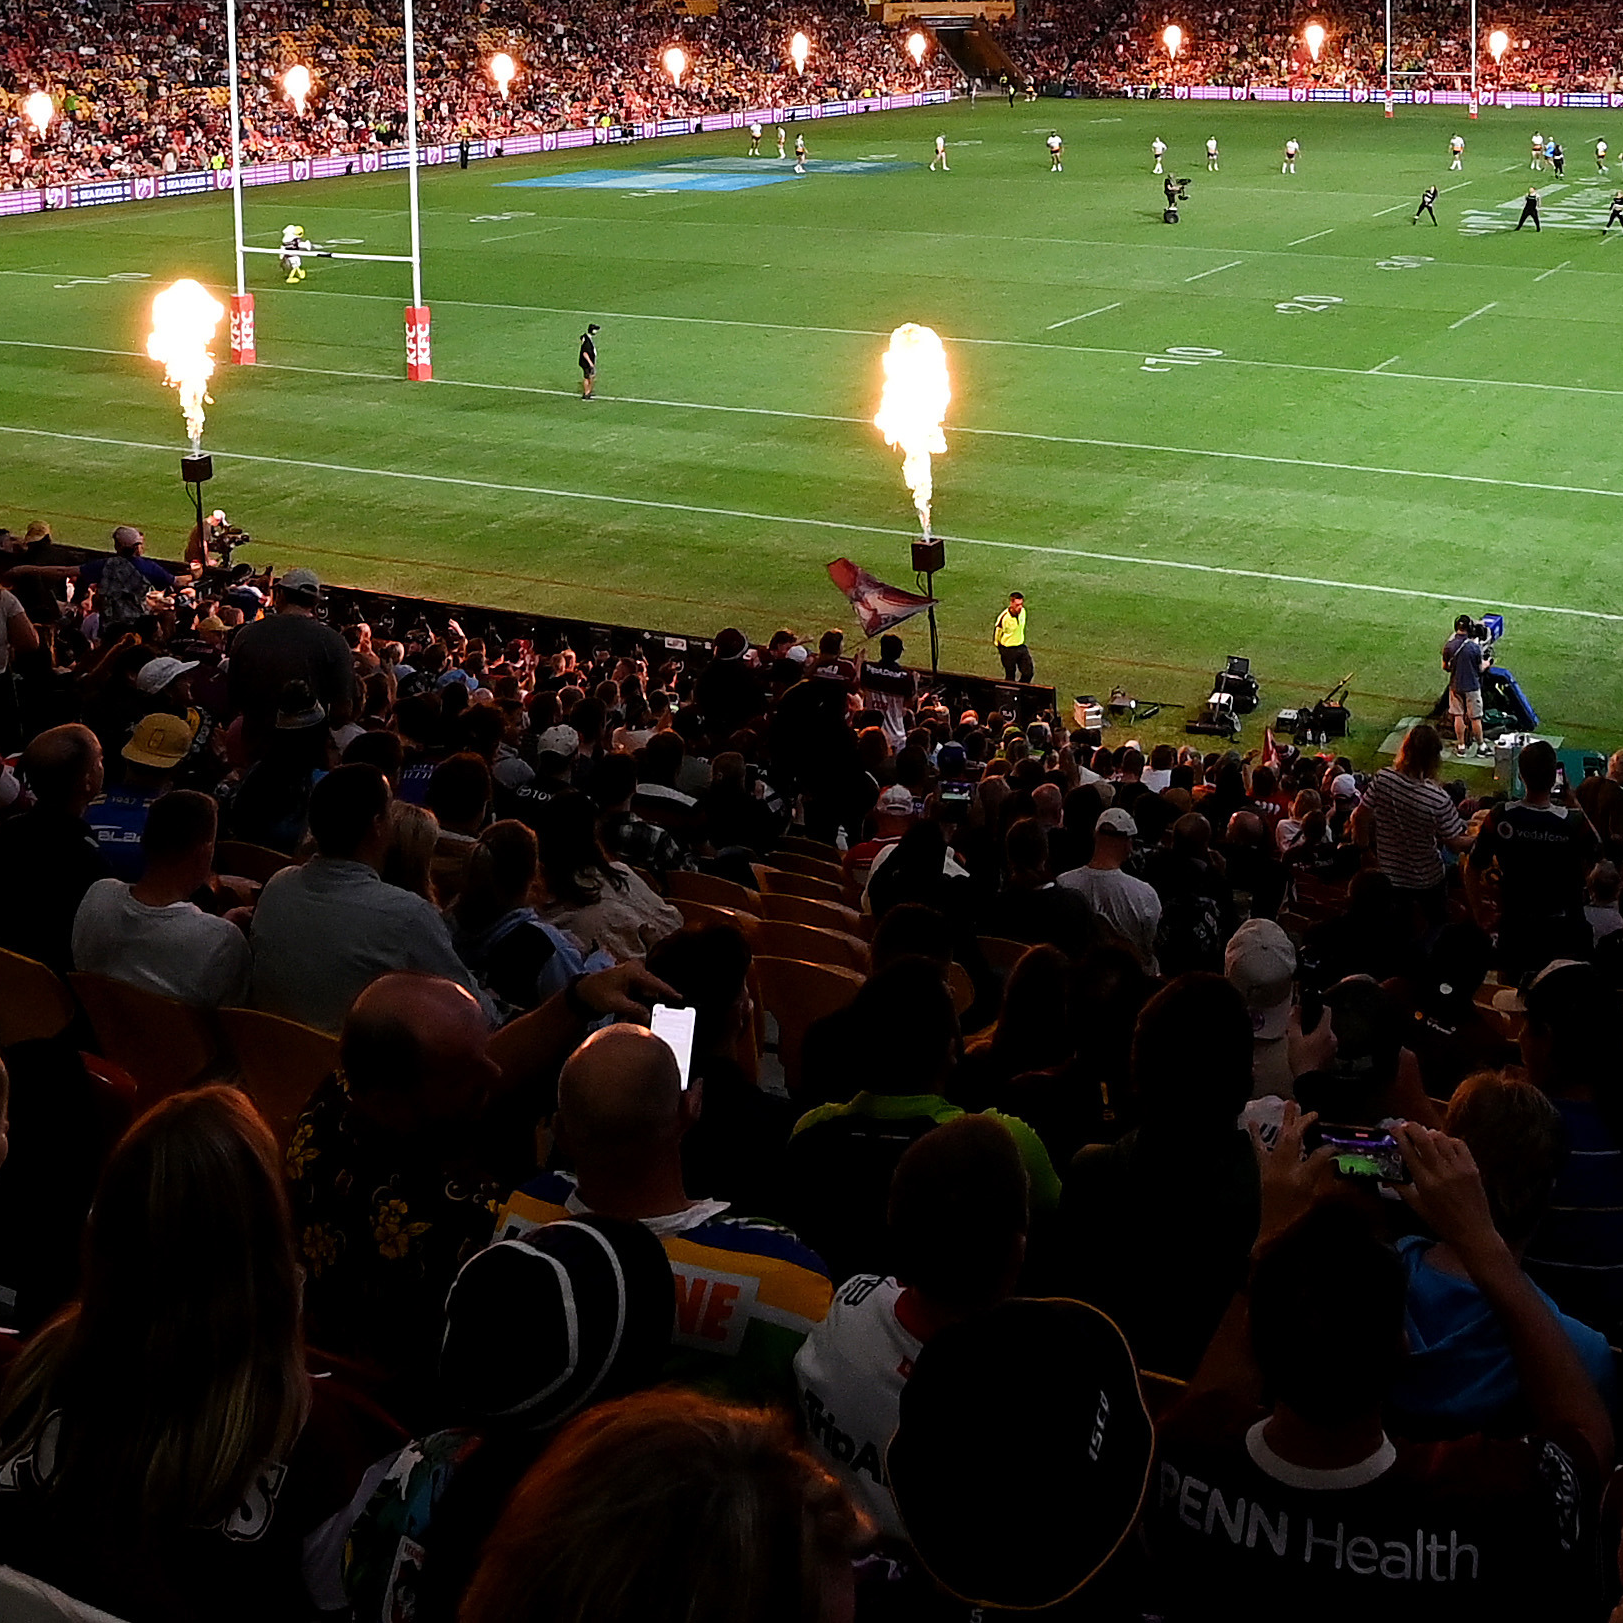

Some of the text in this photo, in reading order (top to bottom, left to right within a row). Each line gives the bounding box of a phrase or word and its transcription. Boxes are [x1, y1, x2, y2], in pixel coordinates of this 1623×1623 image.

[230, 313, 240, 352] KFC
[241, 312, 254, 350] KFC
[406, 323, 416, 367] KFC
[416, 323, 430, 365] KFC
[1159, 1459, 1480, 1583] PENN Health
